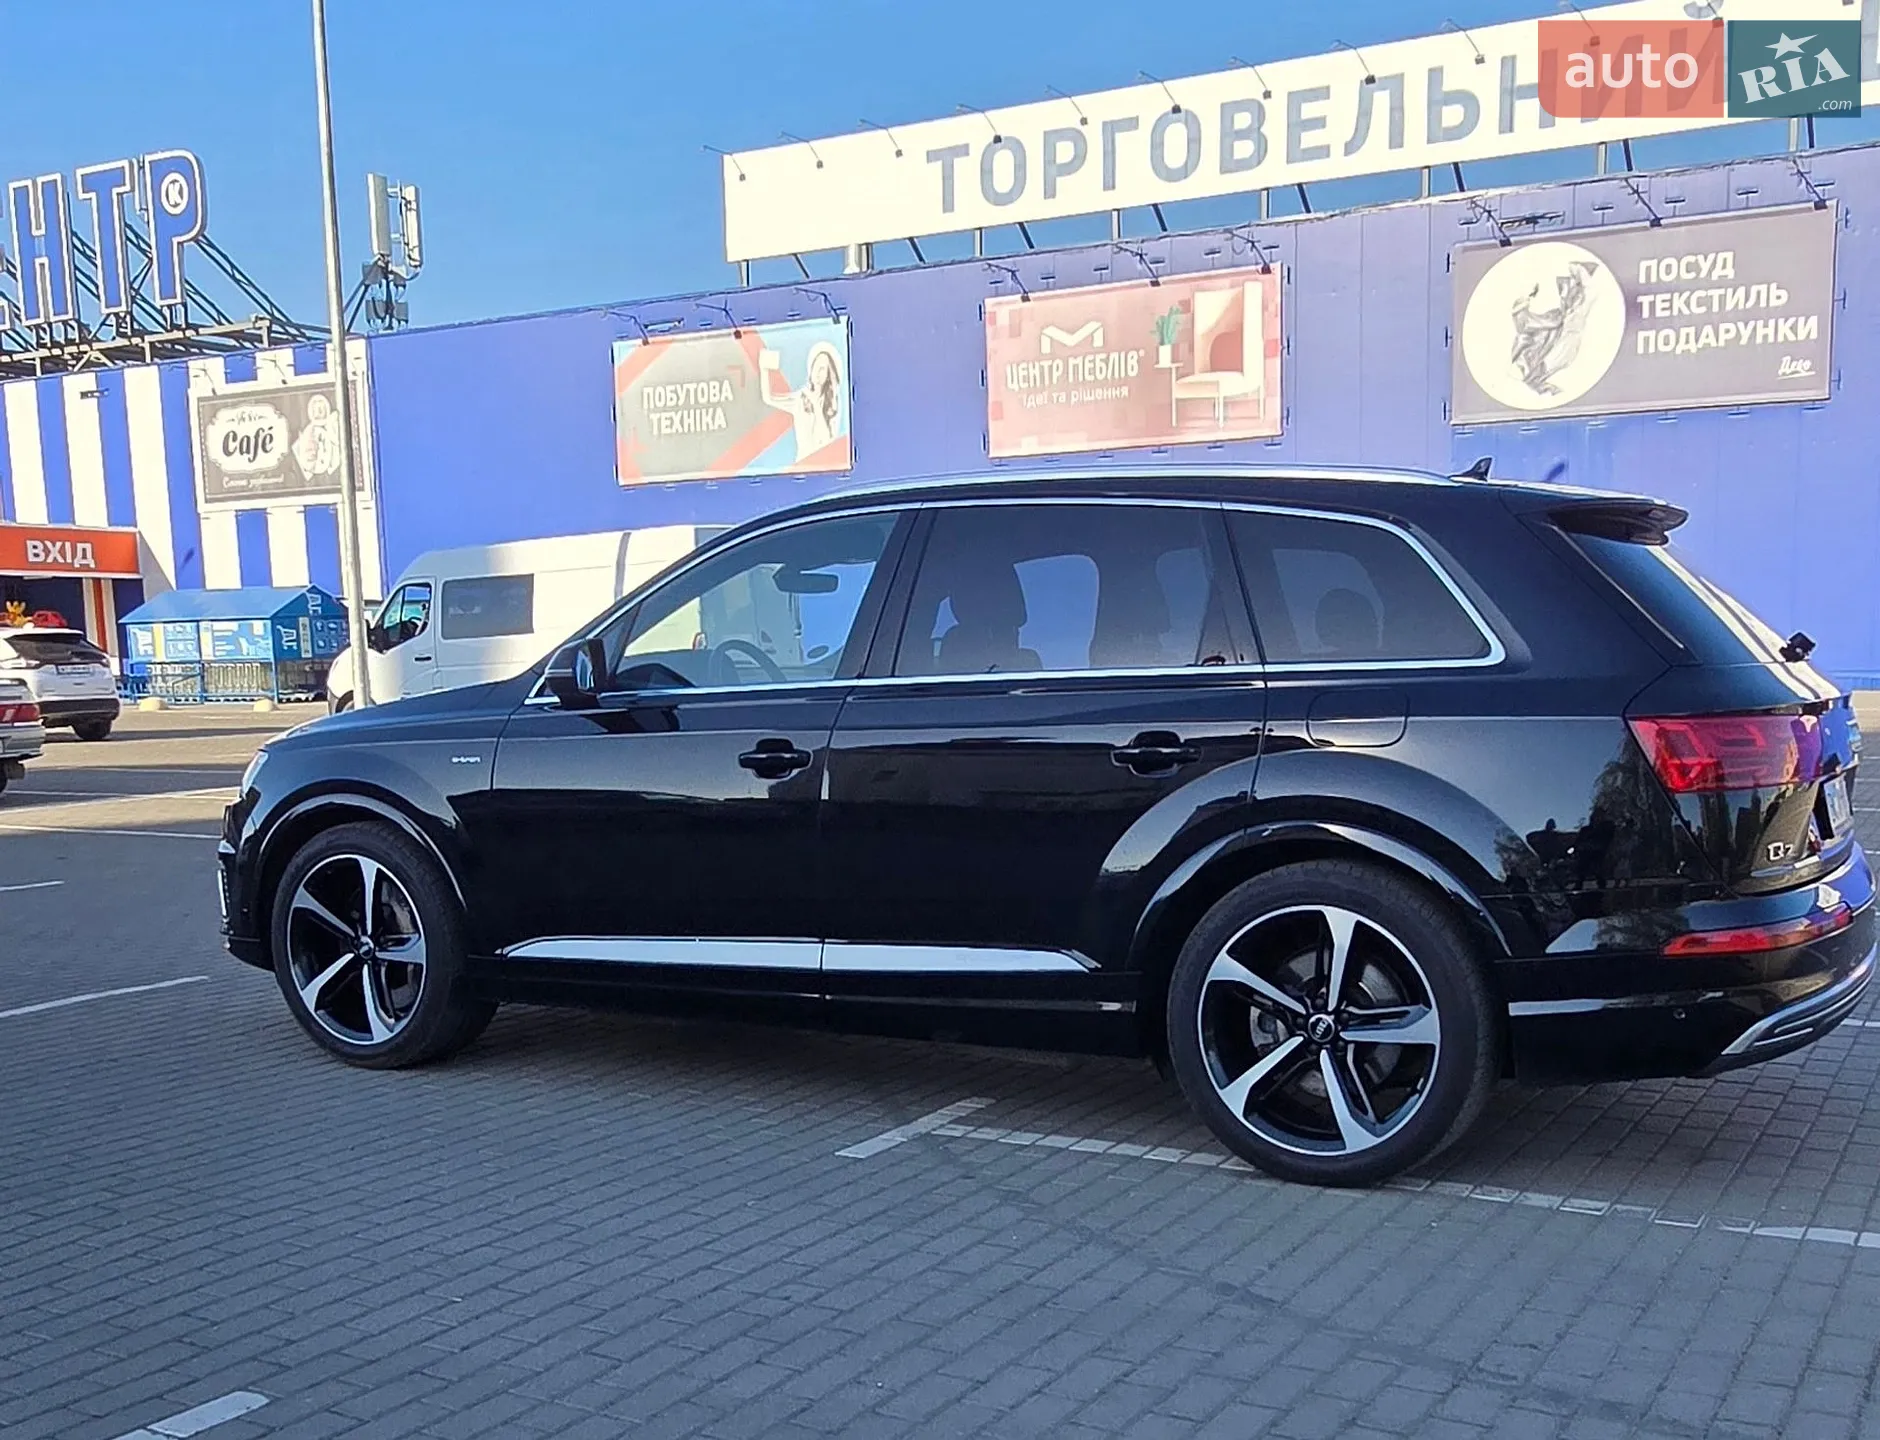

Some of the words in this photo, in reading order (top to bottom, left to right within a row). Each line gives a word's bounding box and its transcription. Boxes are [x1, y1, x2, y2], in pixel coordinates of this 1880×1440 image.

[0, 149, 206, 329] НТР
[1638, 251, 1735, 284] ПОСУД
[1636, 281, 1789, 319] ТЕКСТИЛЬ
[1636, 315, 1818, 354] ПОДАРУНКИ
[1006, 358, 1064, 392] ЦЕНТР
[1068, 350, 1139, 384] МЕБЛІВ
[643, 379, 734, 409] ПОБУТОВА
[1052, 391, 1066, 405] та
[1071, 385, 1129, 406] рішення
[649, 406, 727, 435] ТЕХНІКА
[222, 426, 274, 463] Café
[26, 539, 96, 569] ВХІД
